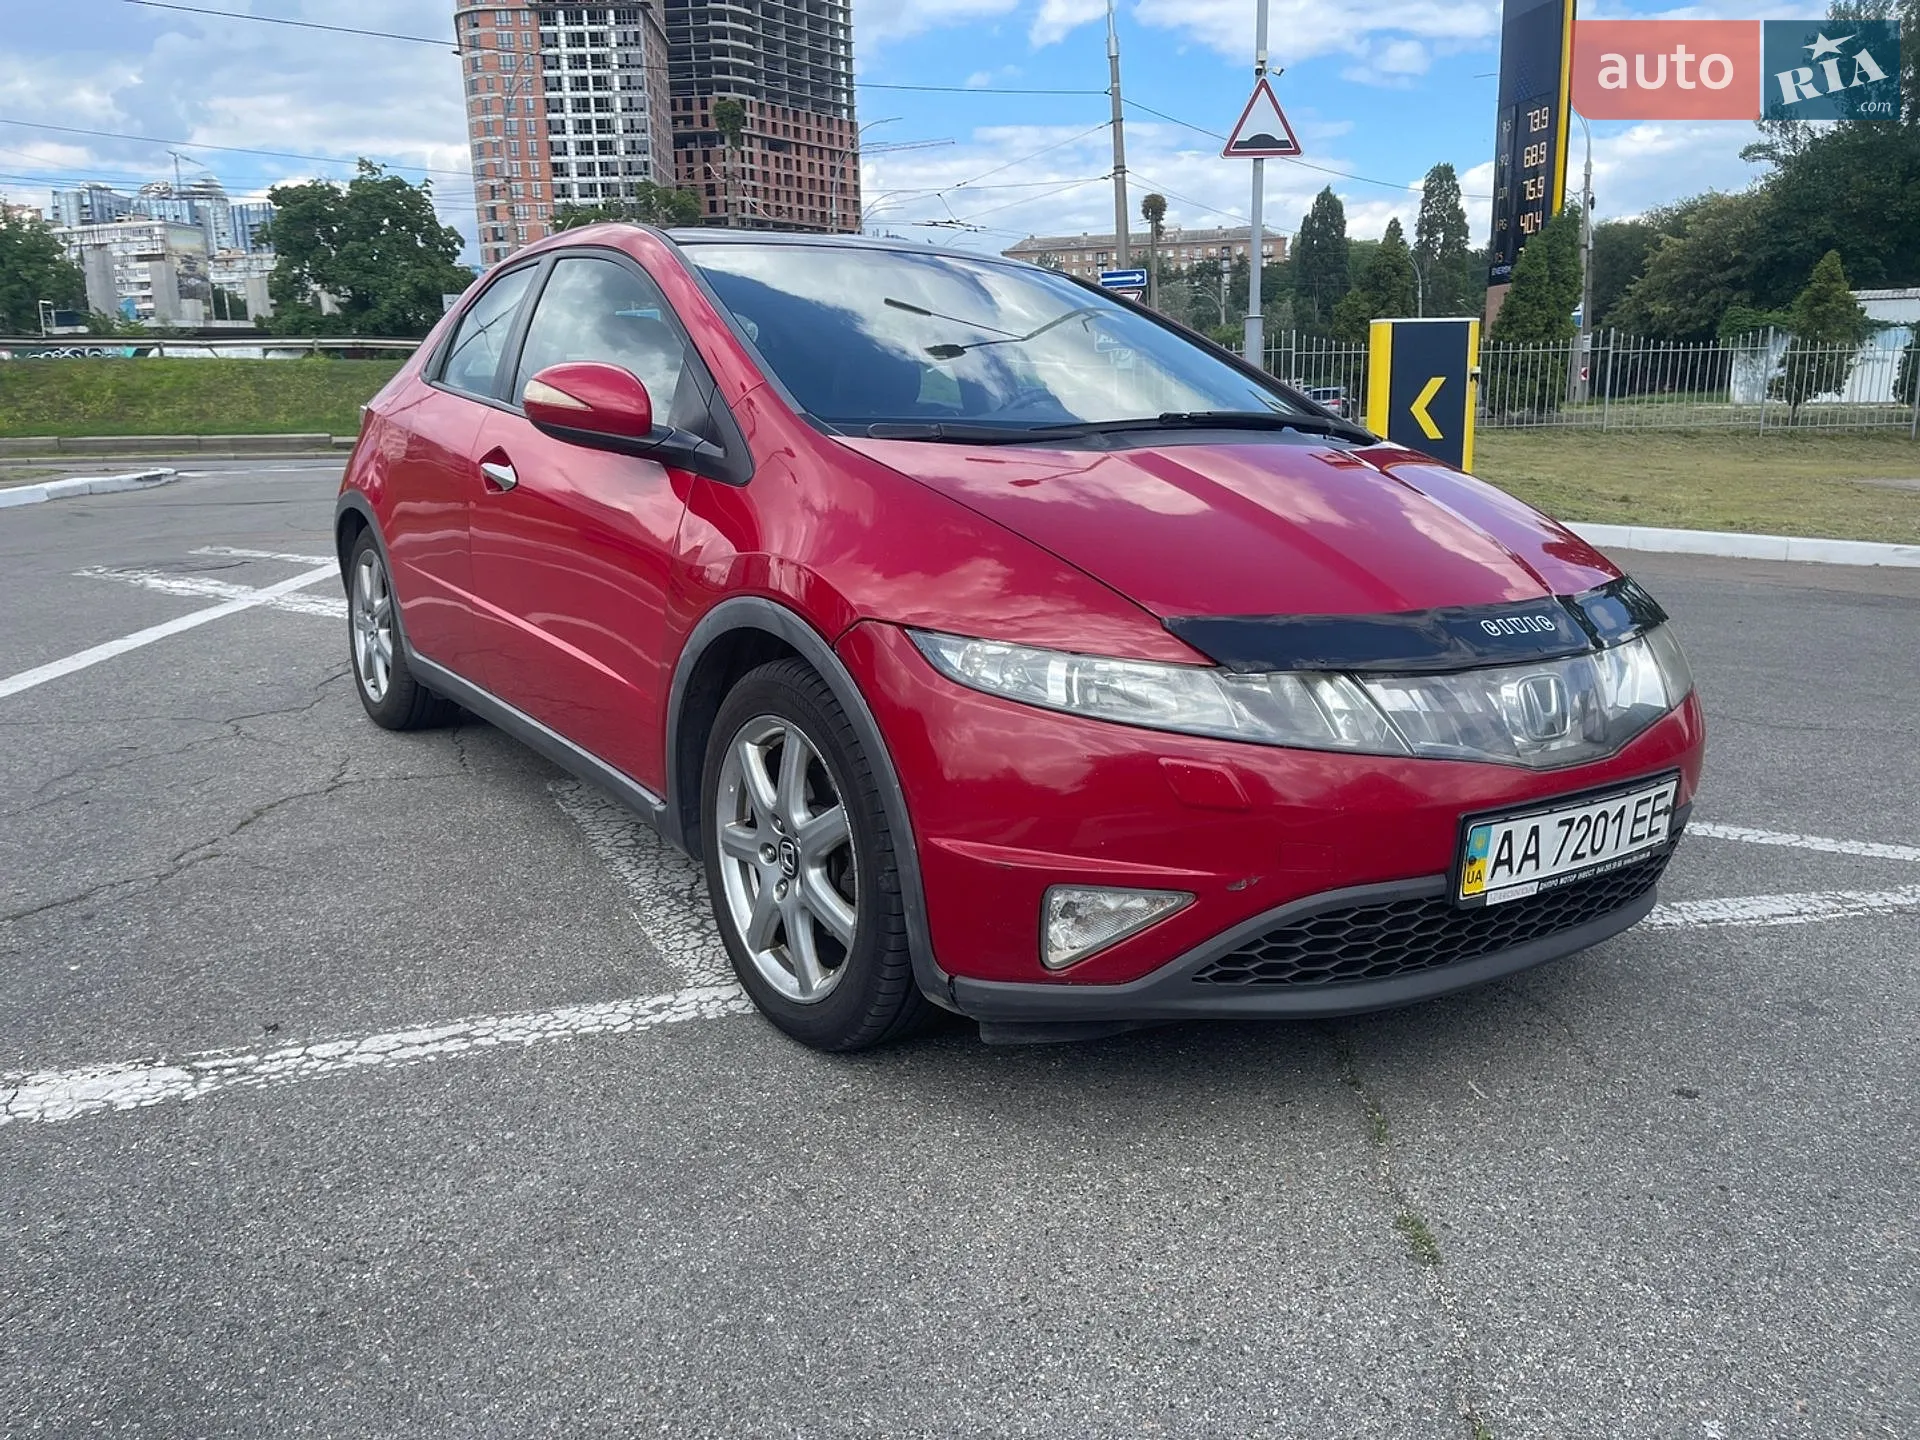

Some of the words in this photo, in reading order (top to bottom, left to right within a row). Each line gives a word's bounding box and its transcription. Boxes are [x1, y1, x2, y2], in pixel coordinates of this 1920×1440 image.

[1502, 120, 1512, 133] 95
[1500, 153, 1510, 166] 92
[1480, 615, 1556, 636] CIVIC
[1489, 825, 1540, 881] AA
[1553, 805, 1627, 867] 7201
[1629, 791, 1669, 844] EE
[1466, 870, 1483, 884] UA
